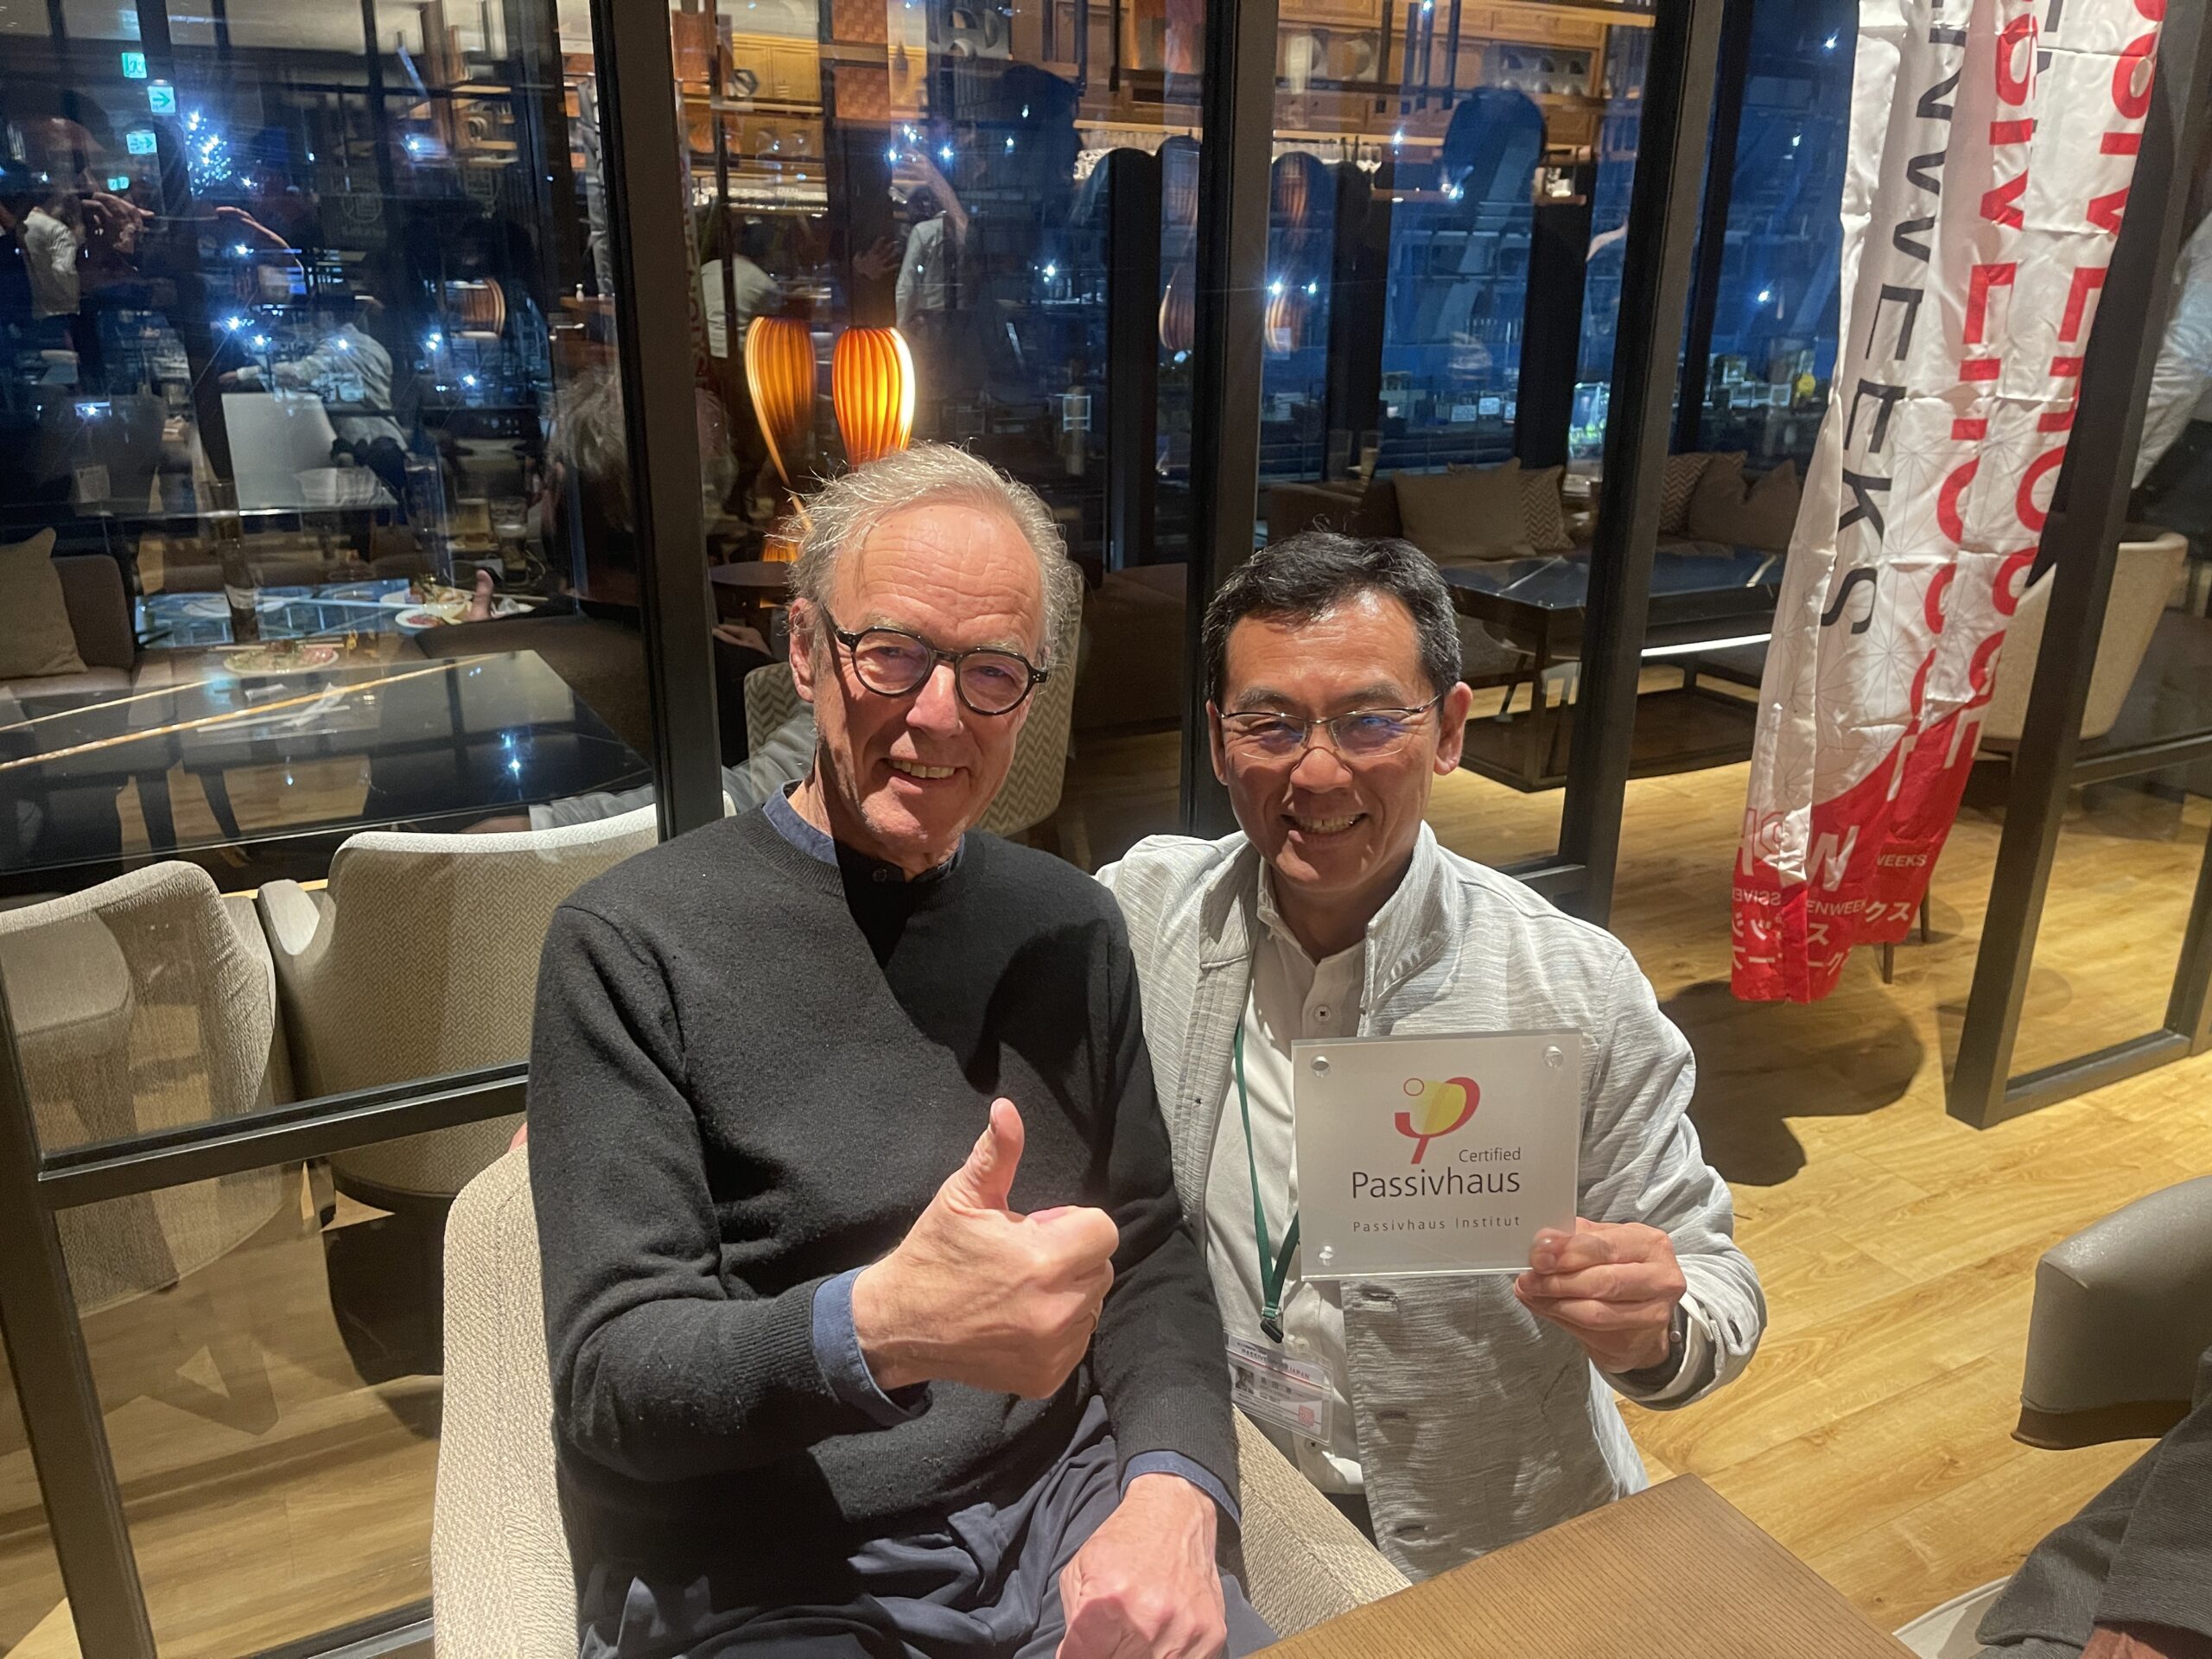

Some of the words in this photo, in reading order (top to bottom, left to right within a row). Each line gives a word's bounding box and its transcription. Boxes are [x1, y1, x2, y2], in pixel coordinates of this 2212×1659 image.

[1459, 1147, 1522, 1163] Certified
[1352, 1166, 1521, 1199] Passivhaus
[1352, 1218, 1446, 1233] Passivhaus
[1456, 1216, 1521, 1229] Institut
